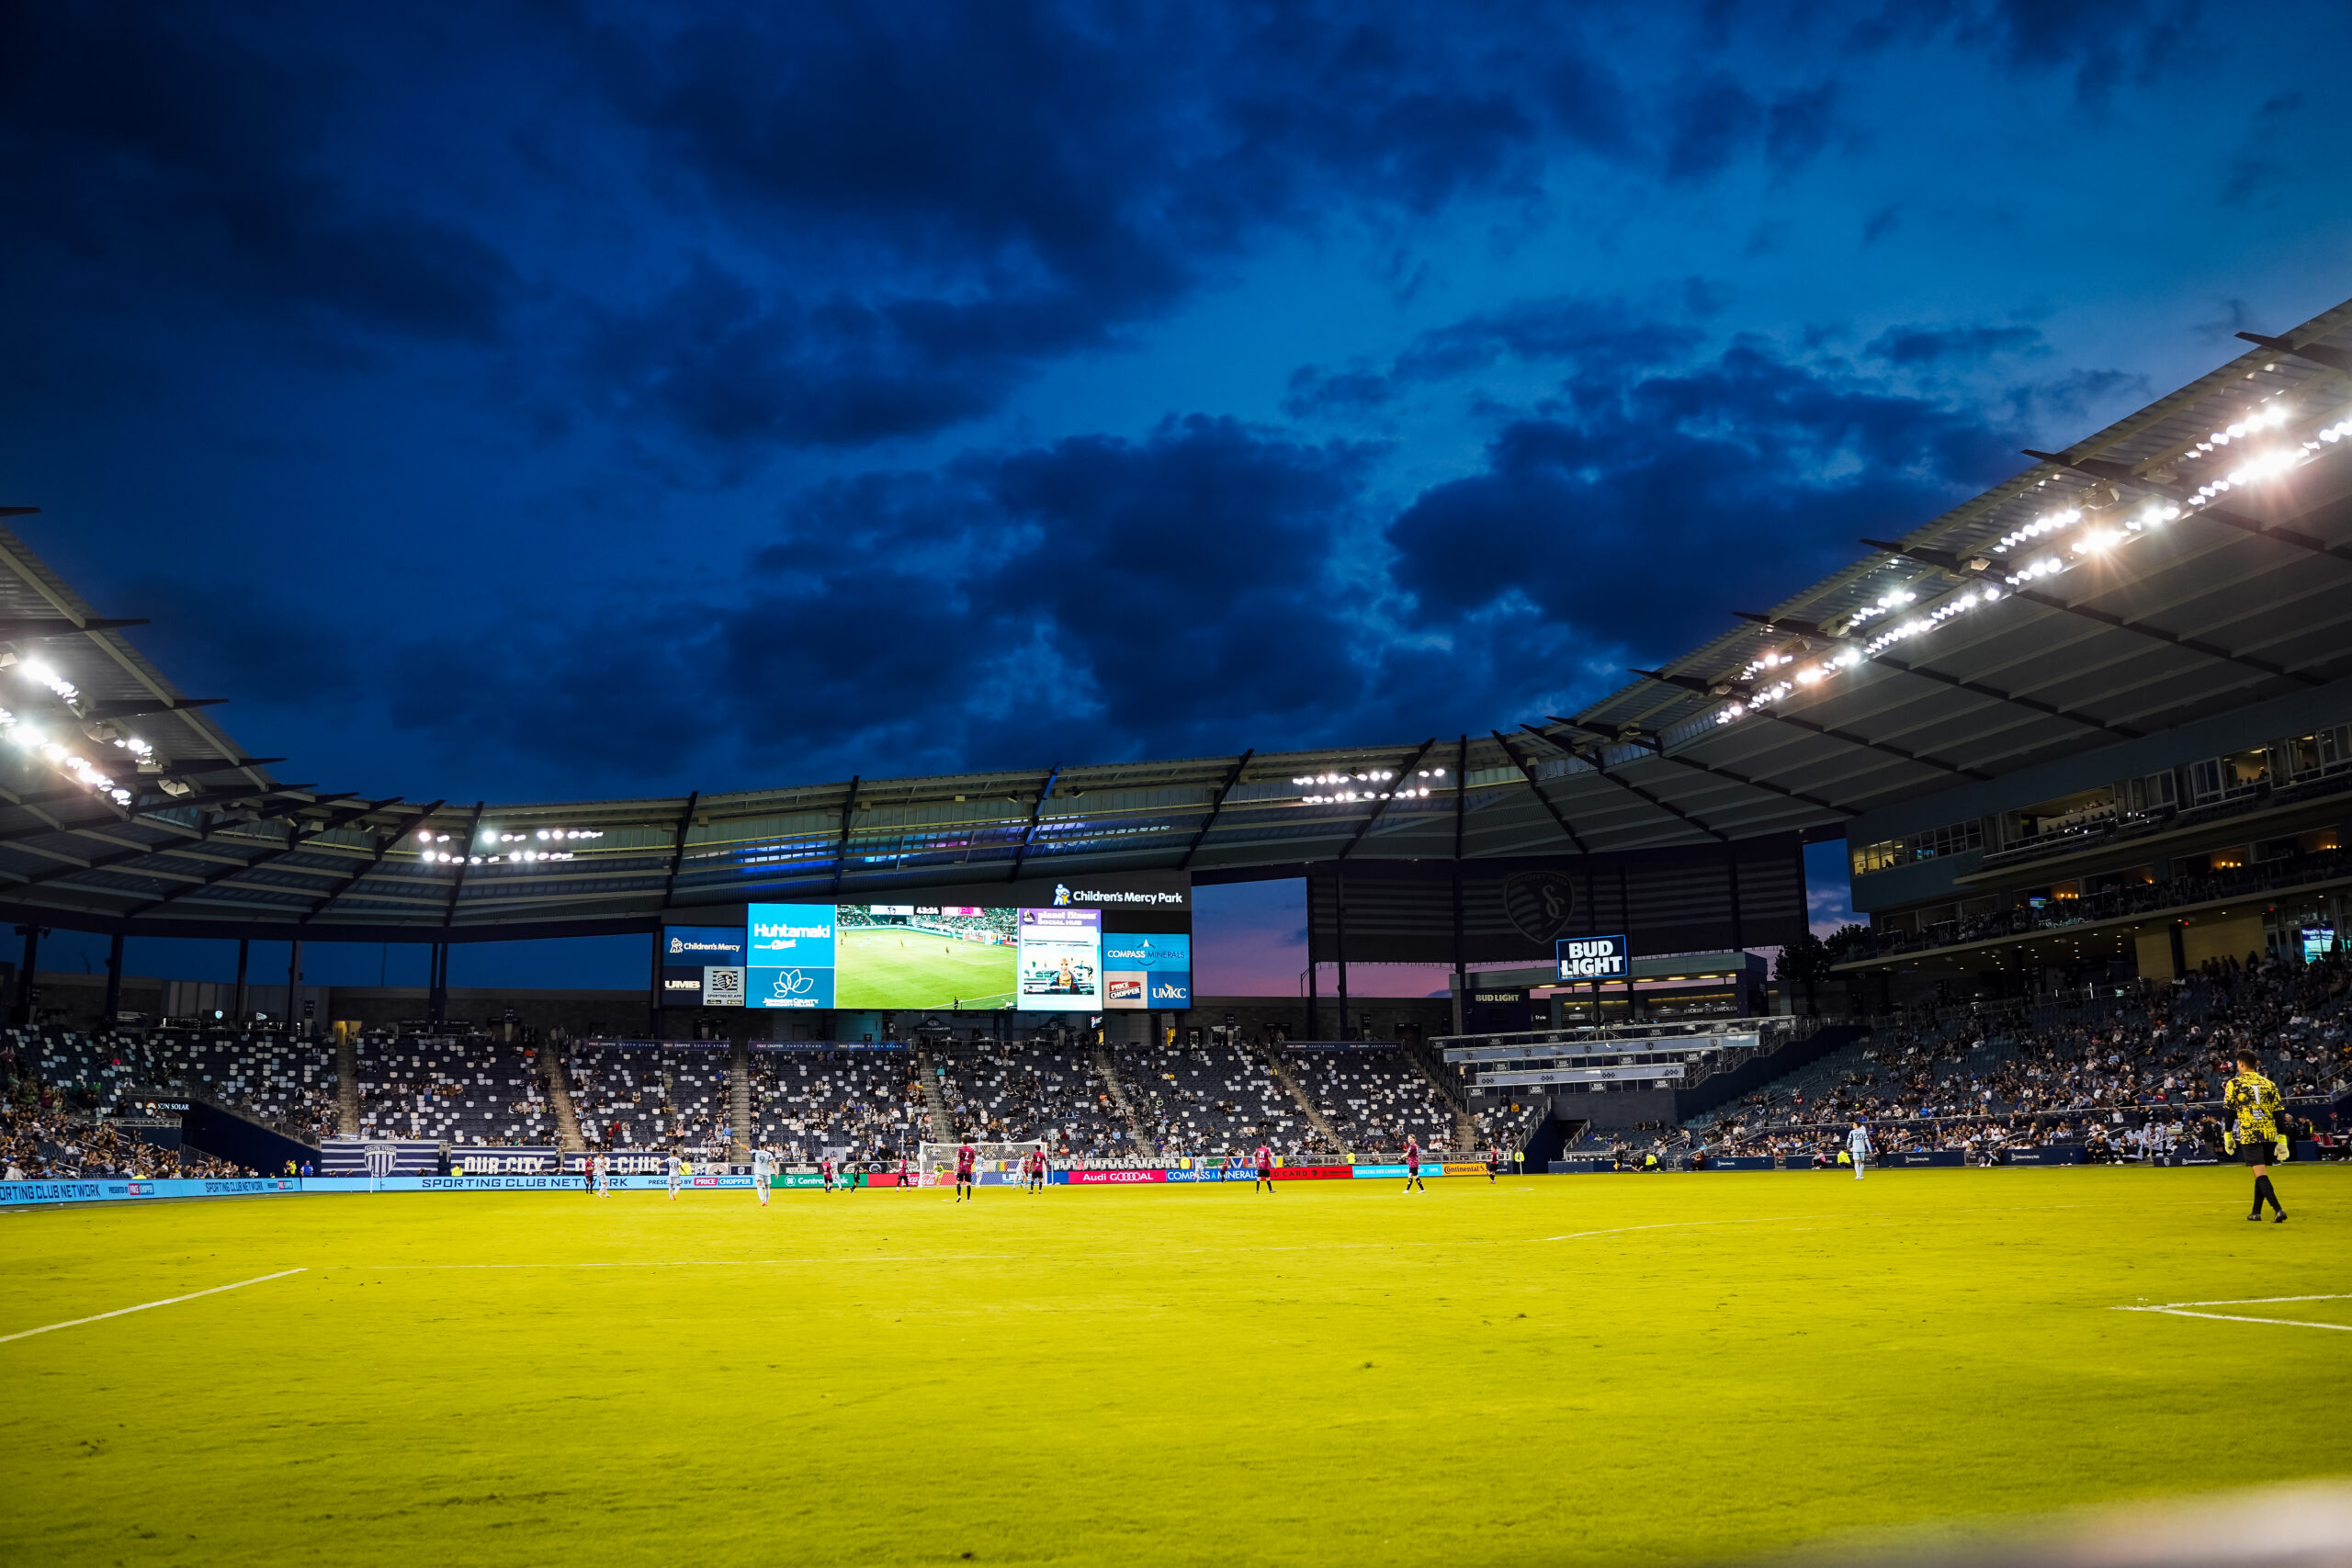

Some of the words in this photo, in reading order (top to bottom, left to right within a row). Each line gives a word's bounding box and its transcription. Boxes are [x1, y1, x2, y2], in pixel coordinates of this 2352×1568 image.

[1073, 891, 1123, 902] Children's
[1125, 892, 1157, 905] Mercy
[1159, 893, 1182, 903] Park
[754, 923, 831, 938] Huhtamaki
[684, 942, 718, 951] Children's
[718, 942, 741, 953] Mercy
[1568, 940, 1613, 959] BUD
[1107, 950, 1146, 958] COMPASS
[1148, 951, 1185, 959] MINERALS
[1561, 956, 1623, 976] LIGHT
[664, 980, 701, 989] UMB
[1111, 981, 1129, 991] PRICE
[1110, 987, 1140, 999] CHOPPER
[1152, 987, 1187, 999] UMKC
[1475, 994, 1494, 1002] BUD
[1495, 993, 1520, 1002] LIGHT
[2251, 1085, 2260, 1105] 1
[170, 1102, 190, 1111] SOLAR
[1854, 1133, 1864, 1141] 20
[759, 1156, 765, 1164] 9
[964, 1151, 970, 1160] 2
[464, 1156, 500, 1175] OUR
[506, 1156, 545, 1174] CITY
[574, 1157, 611, 1172] OR
[617, 1156, 661, 1175] CLUB
[1084, 1158, 1128, 1169] OUNTRIES
[1443, 1165, 1479, 1175] Continental
[1082, 1173, 1107, 1181] Audi
[422, 1179, 502, 1188] SPORTING
[505, 1178, 547, 1188] CLUB
[550, 1178, 628, 1187] NETWRK
[37, 1185, 60, 1200] CLUB
[61, 1183, 101, 1198] NETWORK
